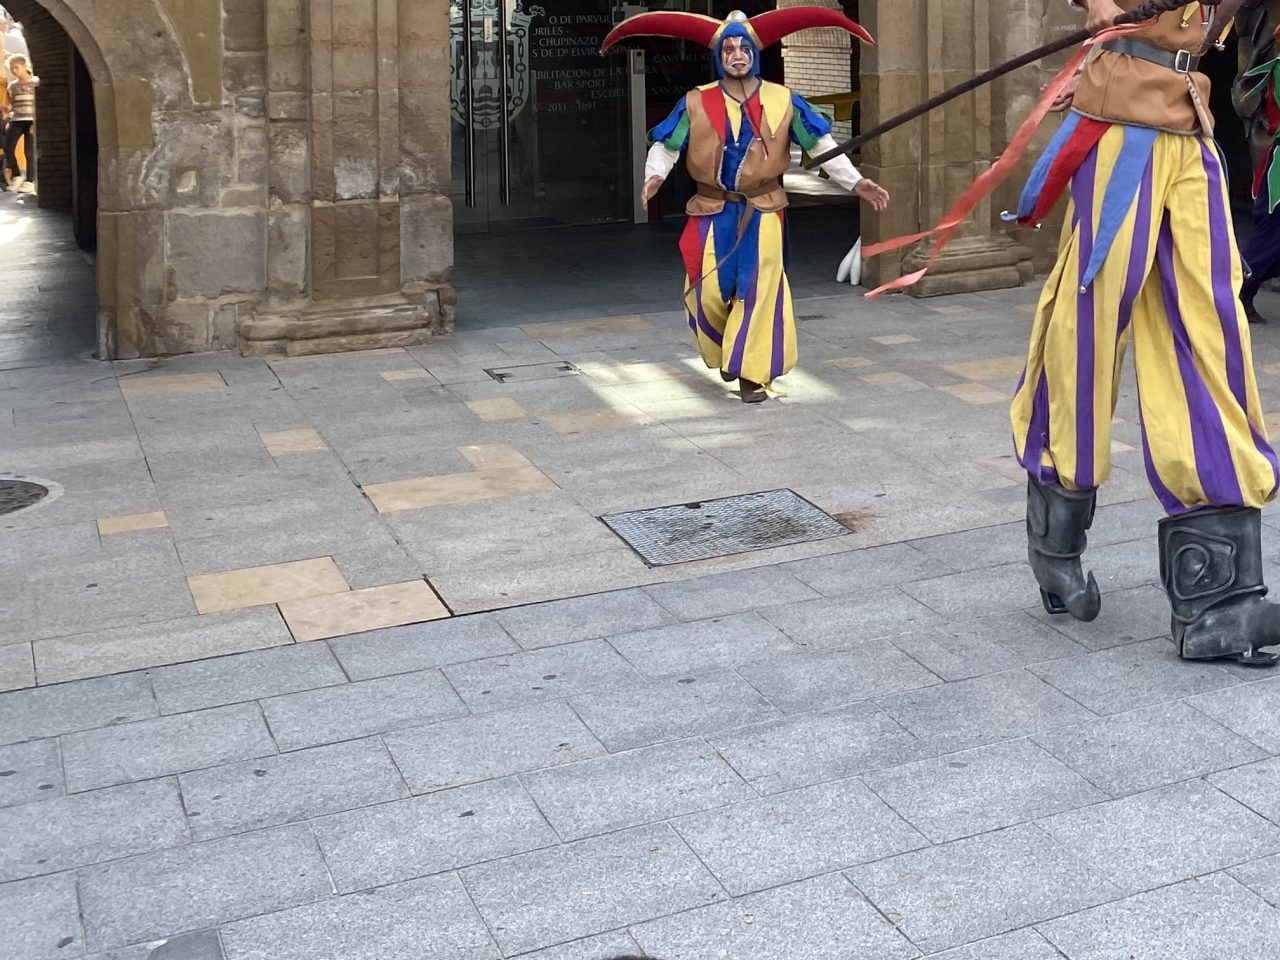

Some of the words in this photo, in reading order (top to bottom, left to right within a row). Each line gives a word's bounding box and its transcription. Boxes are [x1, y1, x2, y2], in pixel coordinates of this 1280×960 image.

[560, 15, 573, 24] DE
[539, 36, 599, 47] CHUPINAZO
[541, 48, 554, 57] DE
[571, 47, 597, 57] ELVIR
[594, 68, 607, 78] DE
[554, 80, 574, 90] BAR
[576, 79, 607, 89] SPORT
